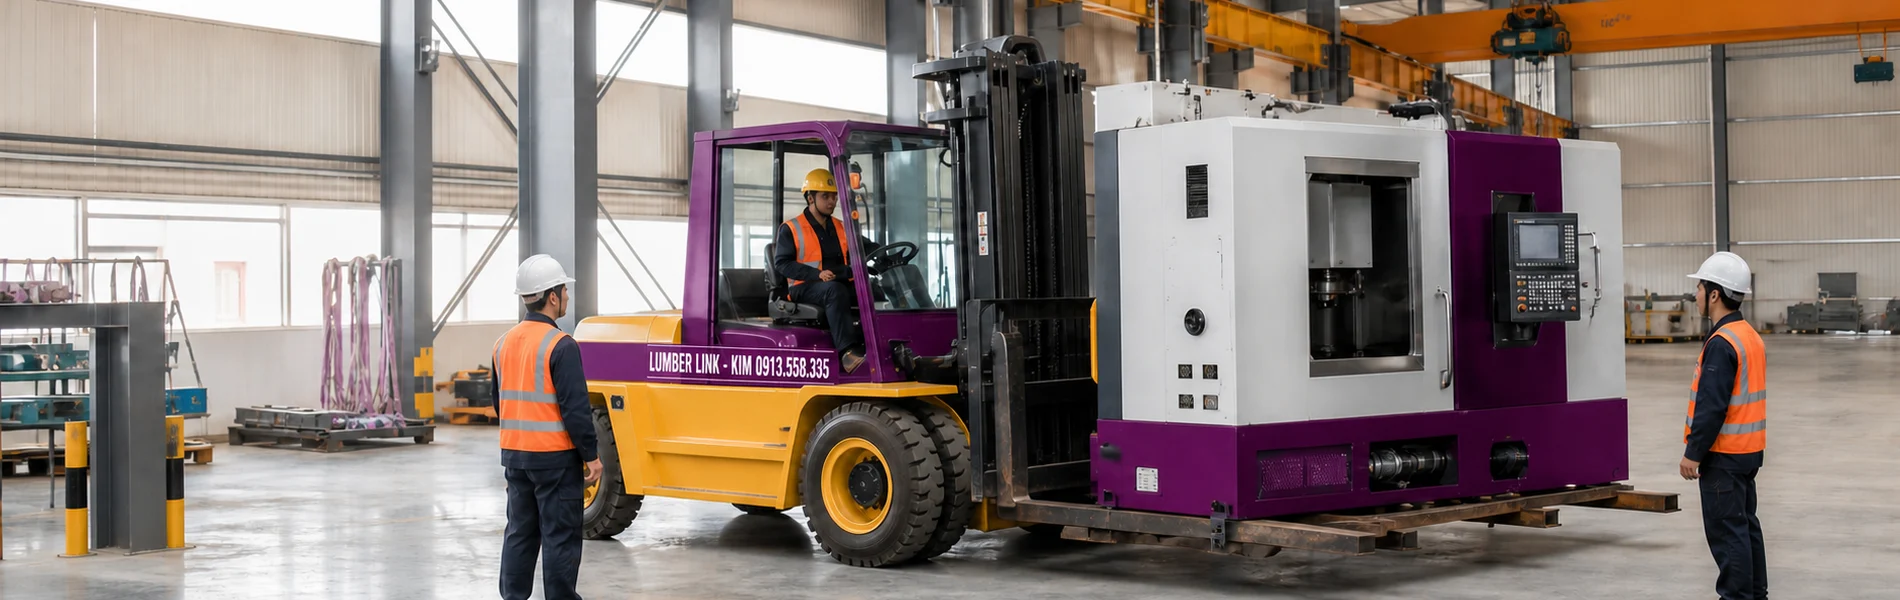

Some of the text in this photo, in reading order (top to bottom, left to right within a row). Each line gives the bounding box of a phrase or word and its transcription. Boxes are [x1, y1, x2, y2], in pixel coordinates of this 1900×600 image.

[650, 351, 692, 373] LUMBER
[695, 353, 720, 374] LINK
[731, 354, 751, 376] KIM
[755, 355, 830, 379] 0913.558.335
